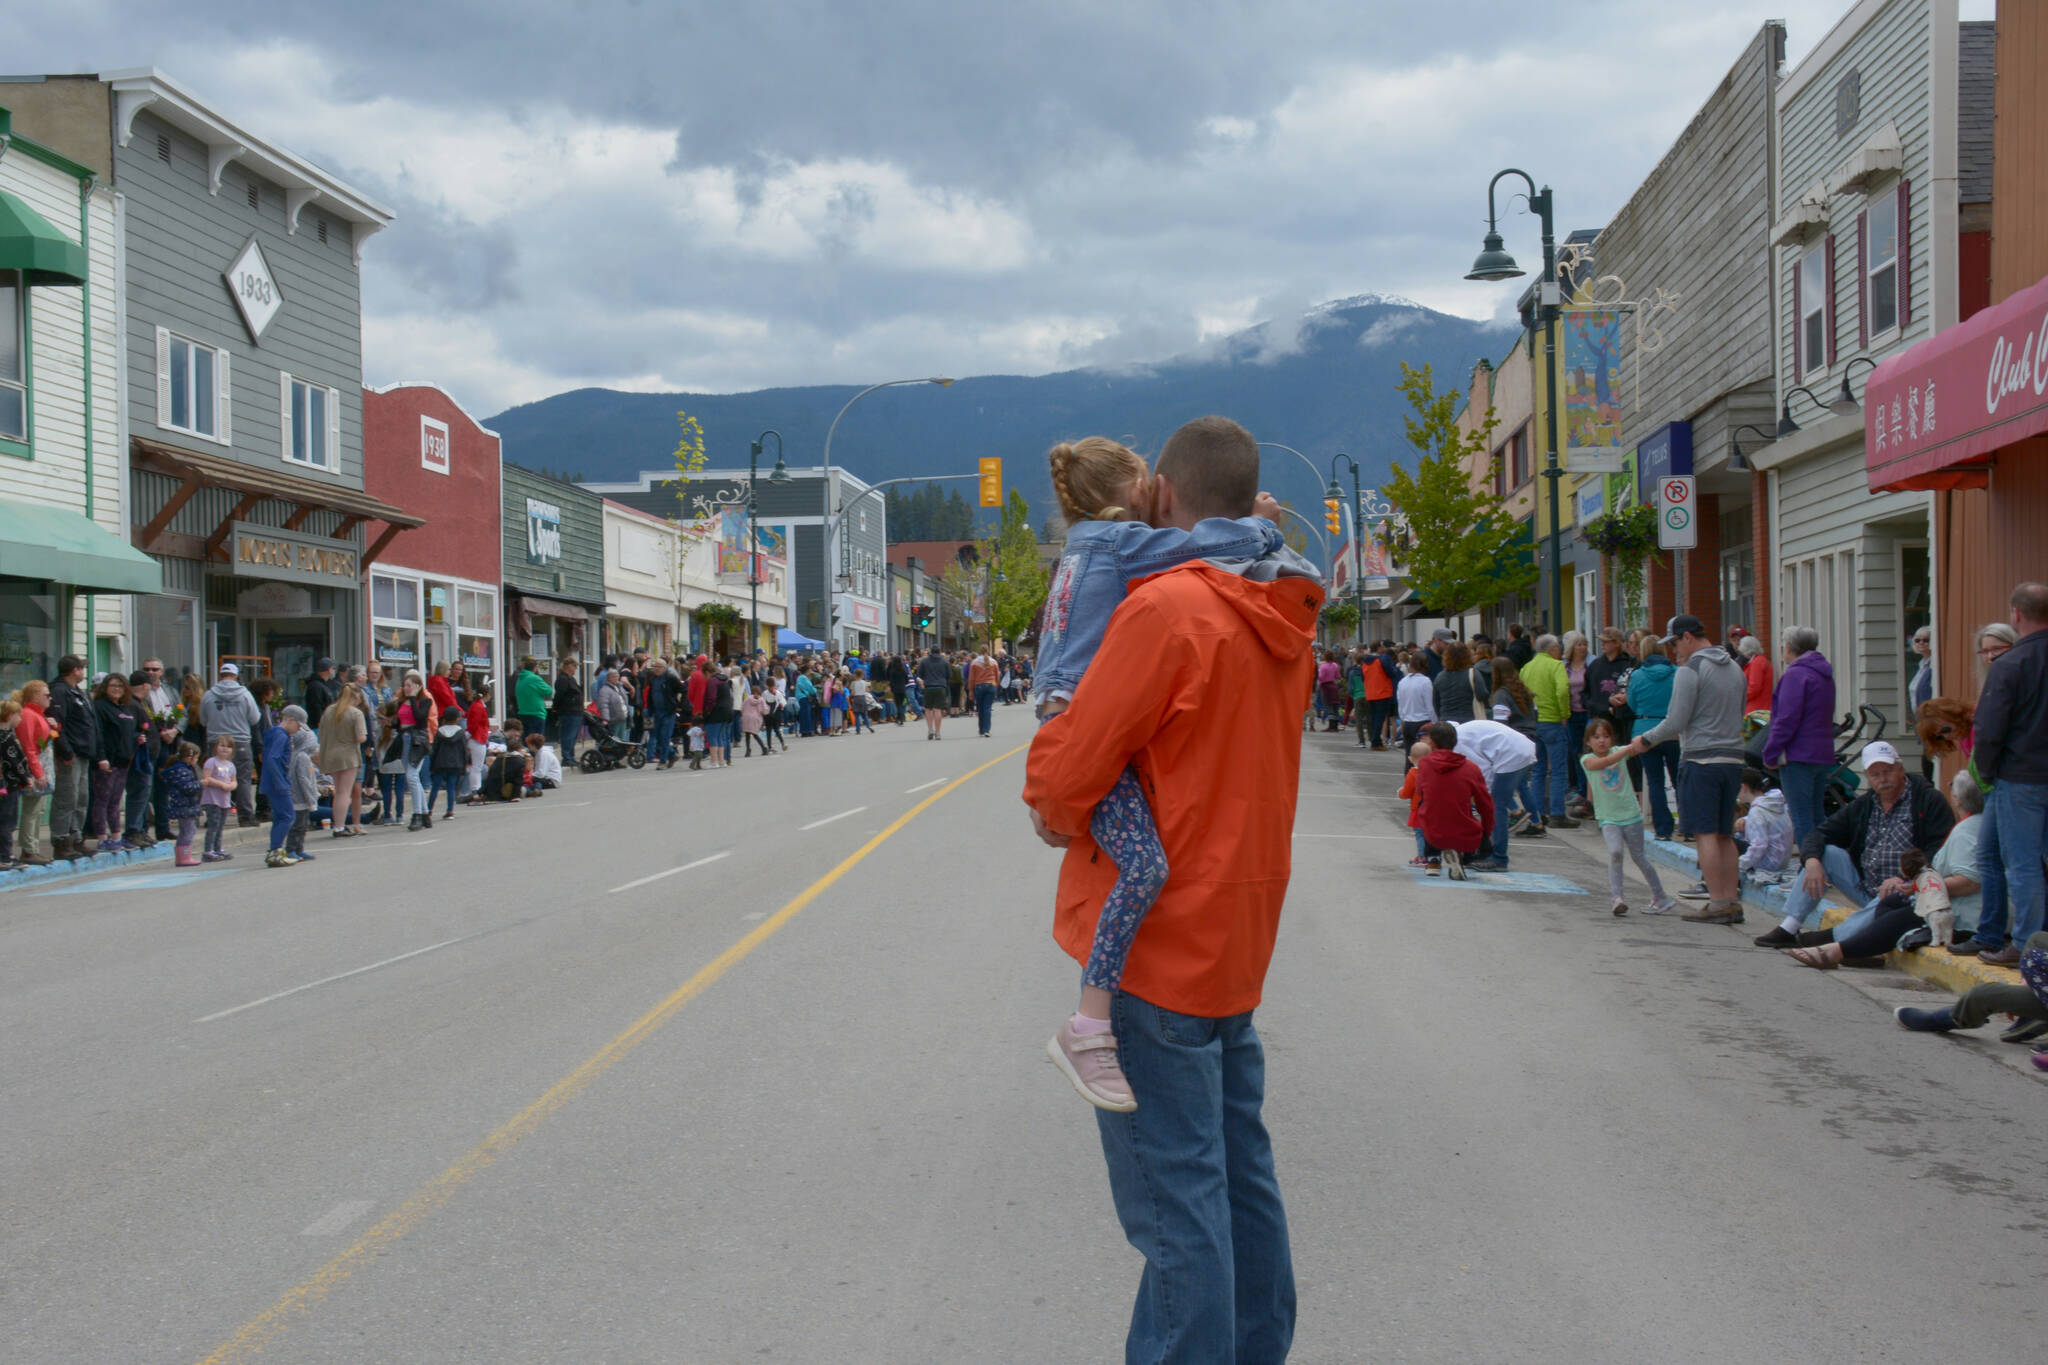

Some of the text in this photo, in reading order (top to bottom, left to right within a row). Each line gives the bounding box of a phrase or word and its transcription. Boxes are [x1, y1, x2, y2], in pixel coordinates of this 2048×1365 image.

[241, 272, 271, 305] 1933
[1986, 331, 2034, 414] Club
[425, 432, 445, 459] 1938
[239, 536, 355, 577] MORRIS FLOWERS
